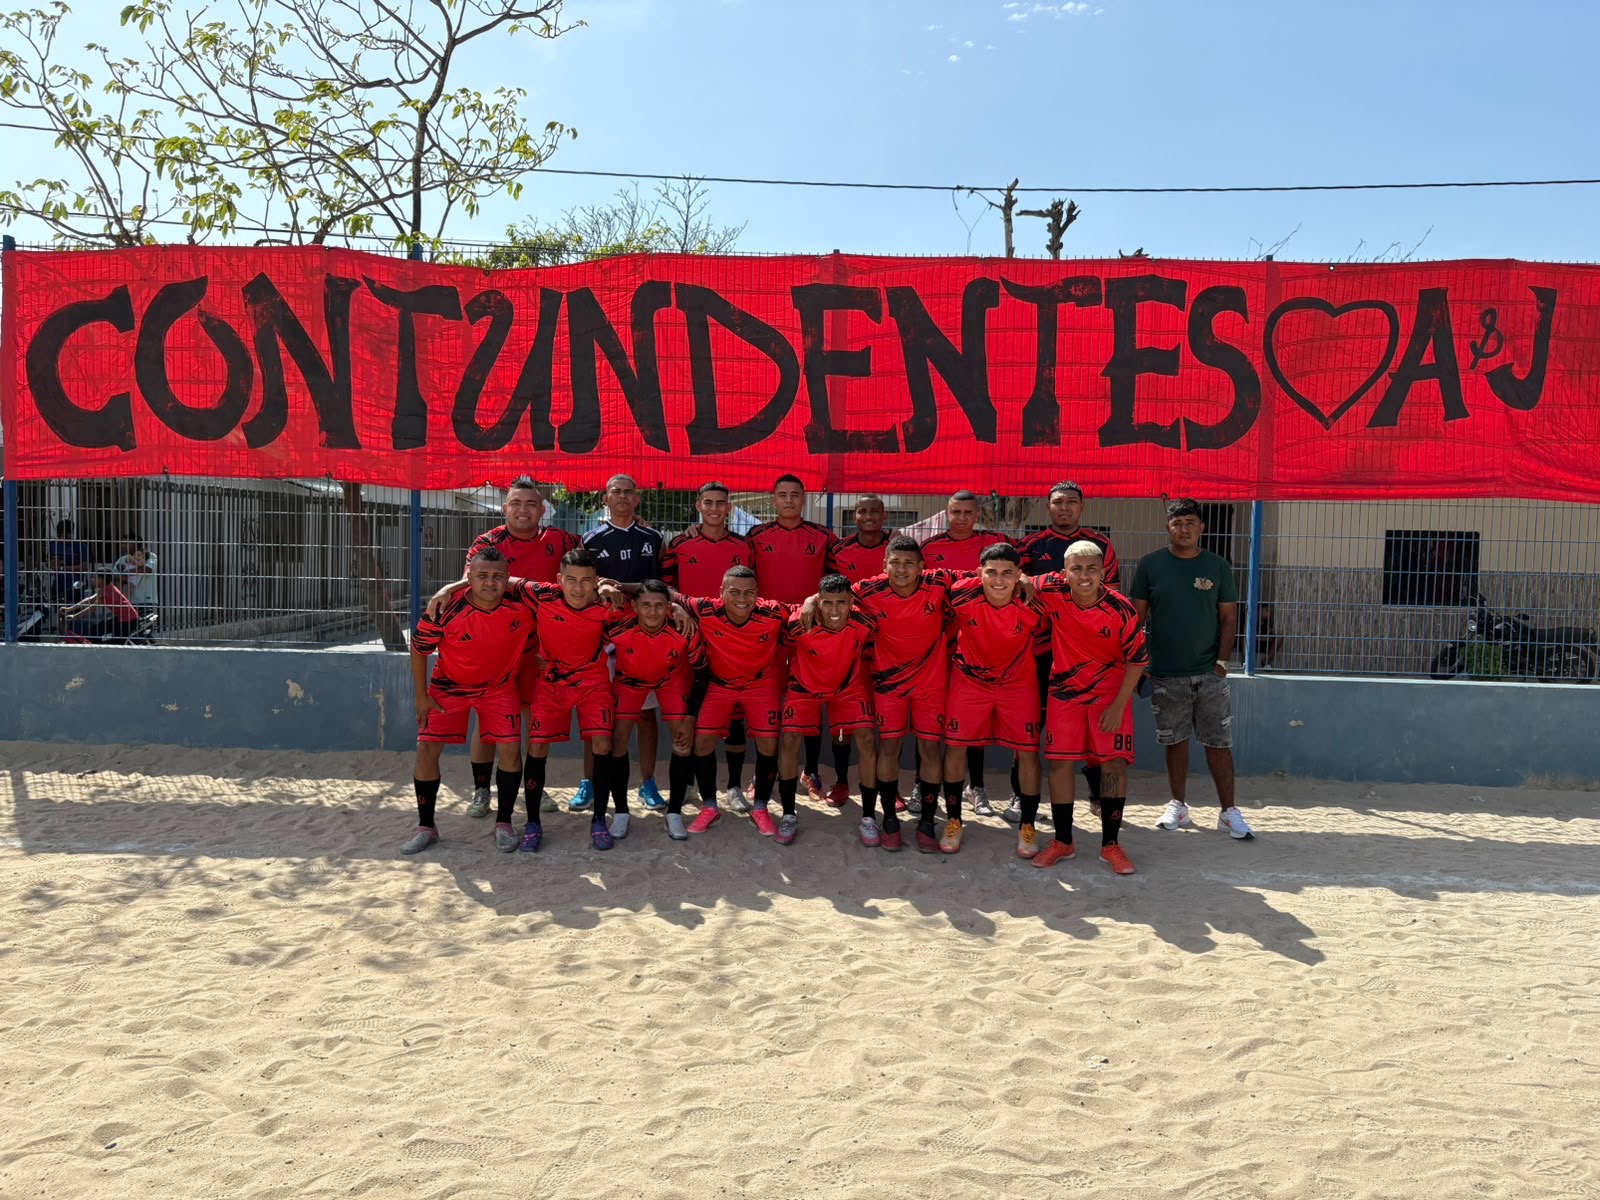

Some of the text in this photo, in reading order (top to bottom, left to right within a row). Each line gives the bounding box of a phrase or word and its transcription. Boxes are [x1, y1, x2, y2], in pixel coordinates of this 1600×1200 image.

[26, 272, 1262, 455] CONTUNDENTES
[620, 549, 631, 560] DT
[859, 701, 873, 717] 10
[1114, 733, 1132, 751] 88
